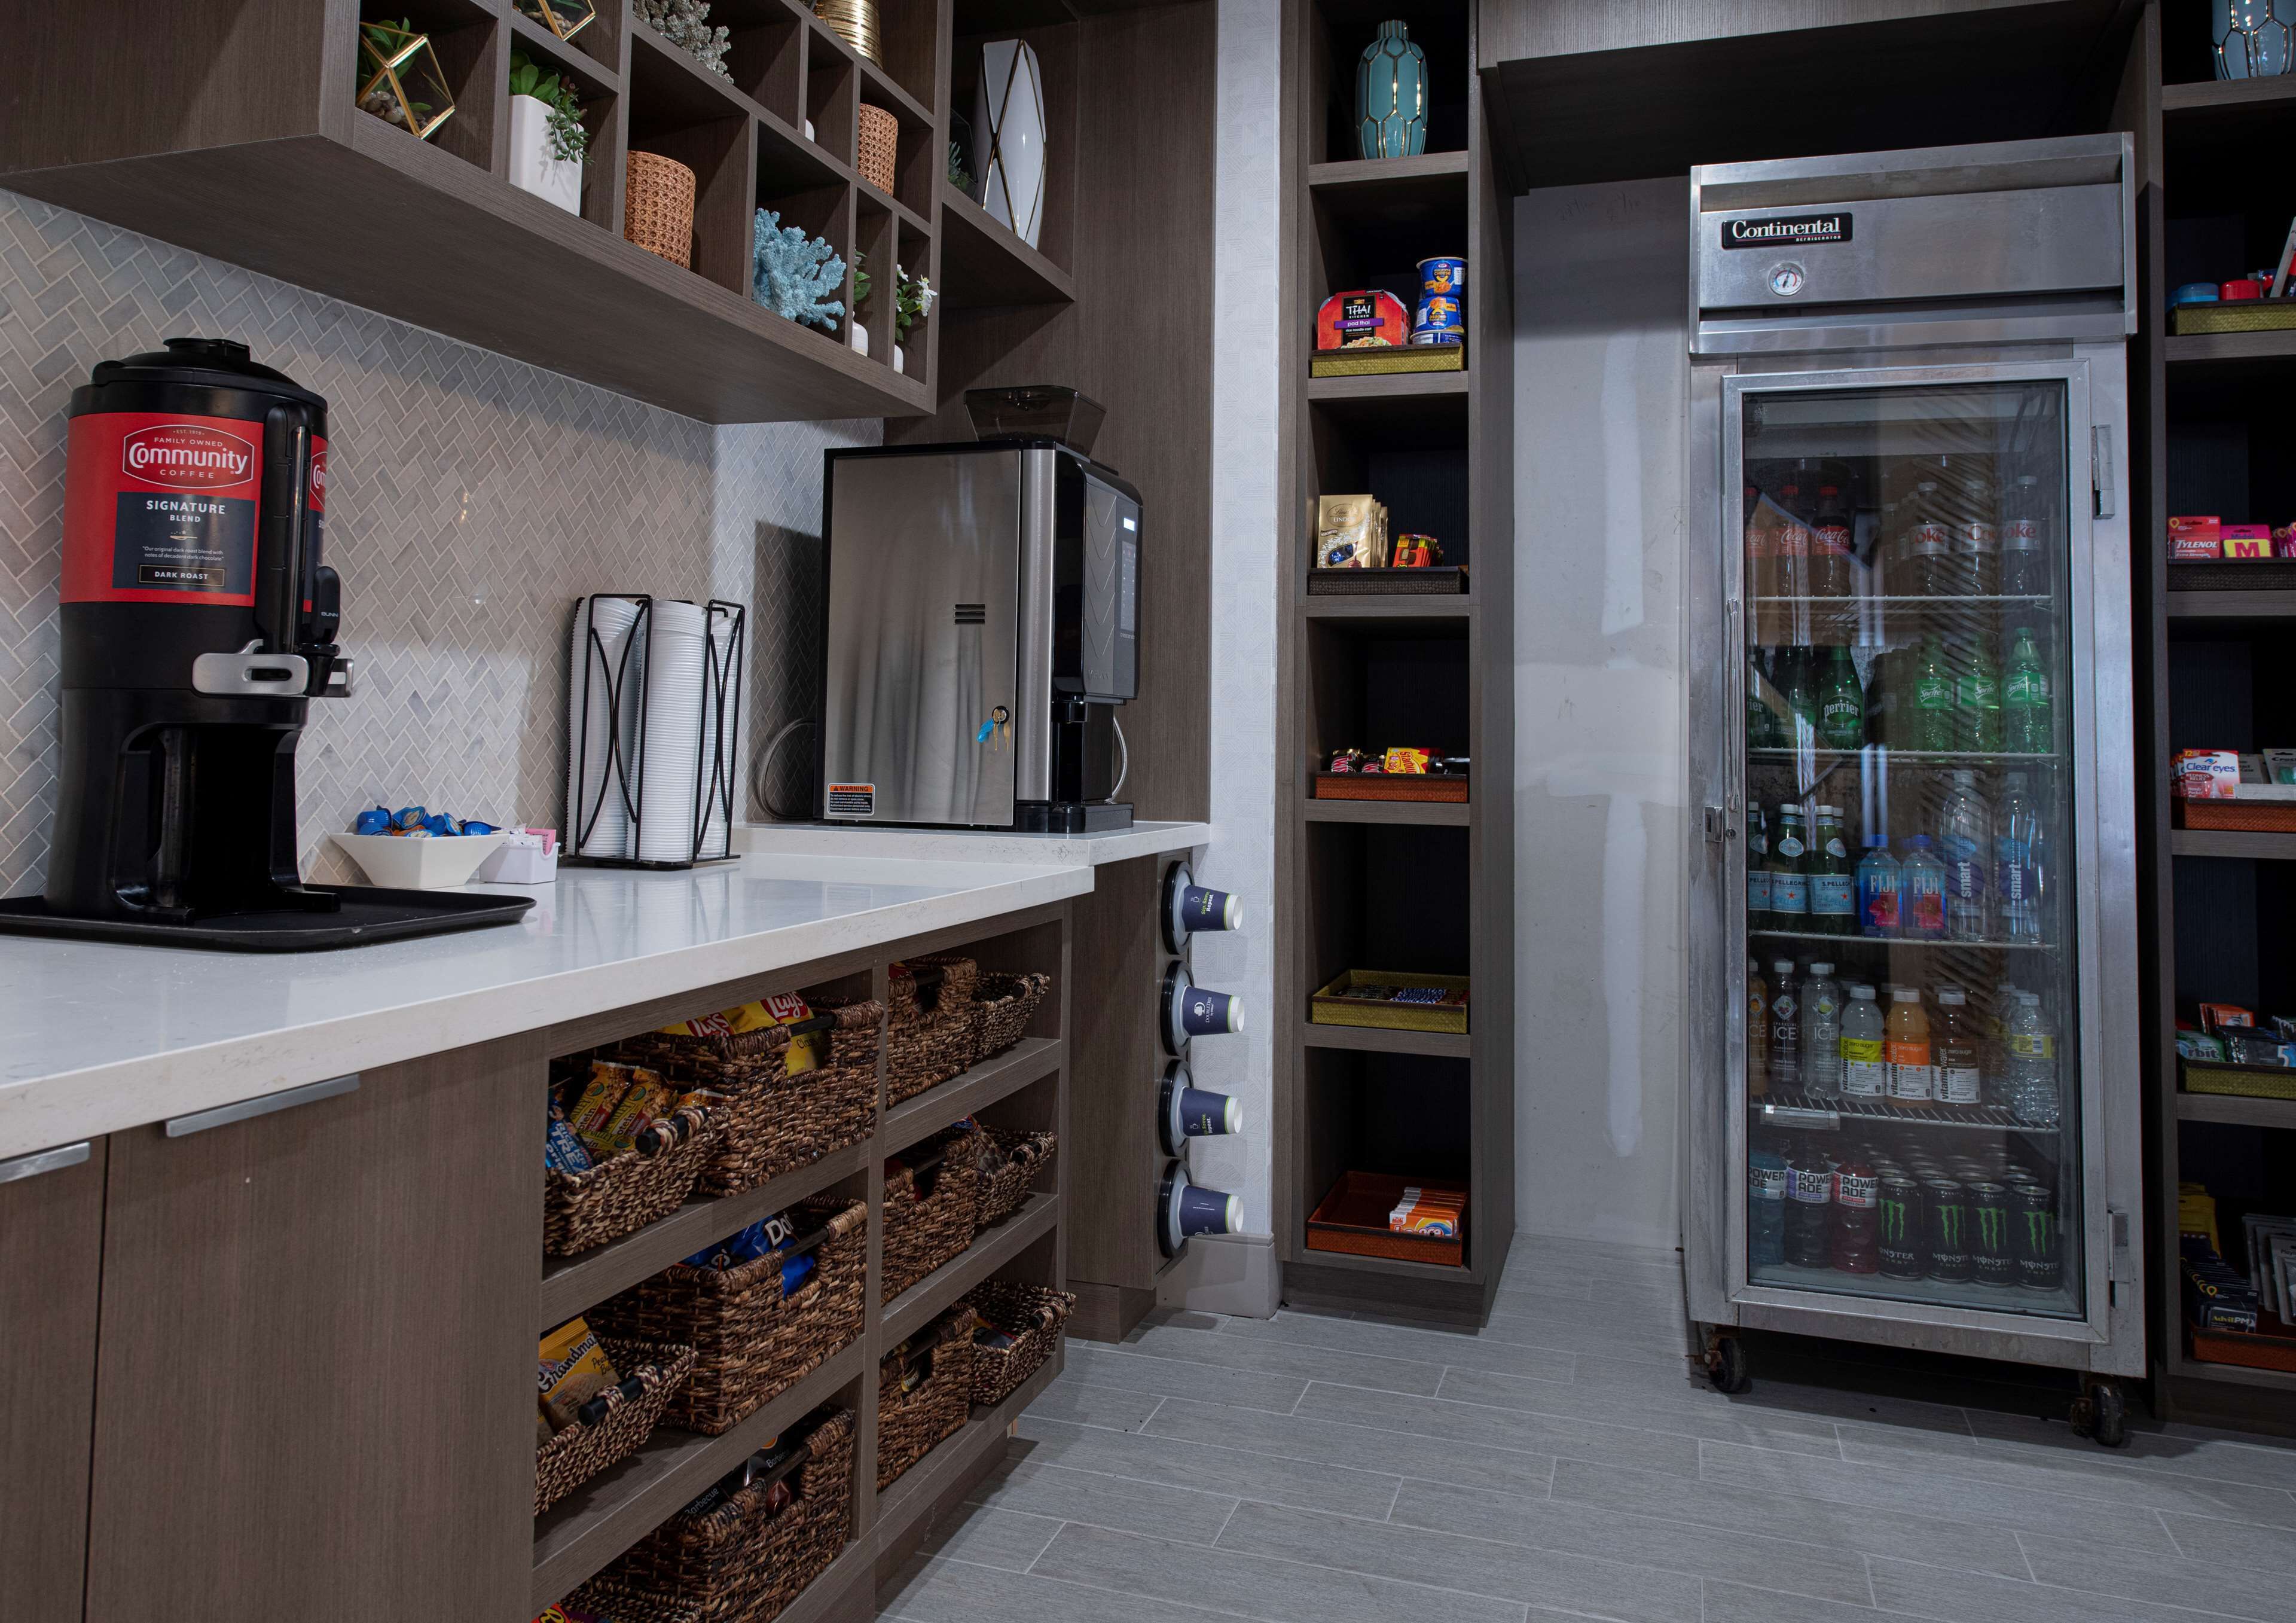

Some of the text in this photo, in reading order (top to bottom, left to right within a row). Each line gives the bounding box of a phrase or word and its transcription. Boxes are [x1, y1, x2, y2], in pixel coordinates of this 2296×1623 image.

[1732, 218, 1841, 239] Continental
[1345, 304, 1371, 315] THAI
[129, 443, 248, 474] Community
[160, 469, 214, 478] COFFEE
[146, 500, 225, 514] SIGNATURE
[169, 514, 201, 523] BLEND
[1915, 528, 1945, 544] oke
[2003, 523, 2036, 539] oke
[2176, 540, 2218, 549] TYLENOL
[1920, 688, 1943, 698] Sprite
[1824, 701, 1860, 722] perrier
[2186, 762, 2210, 771] Clear
[1870, 875, 1895, 893] FIJI
[1913, 877, 1939, 895] FIJI
[1749, 1024, 1767, 1038] CE
[1773, 1026, 1797, 1041] ICE
[1813, 1026, 1836, 1041] ICE
[2176, 1039, 2219, 1059] Orbit
[1799, 1173, 1831, 1185] POWE
[1799, 1182, 1822, 1194] ADE
[1842, 1186, 1866, 1198] ADE
[1932, 1253, 1968, 1264] MONST
[1973, 1255, 2011, 1265] MONST
[2020, 1259, 2059, 1270] MONST
[539, 1333, 598, 1393] Grandma'
